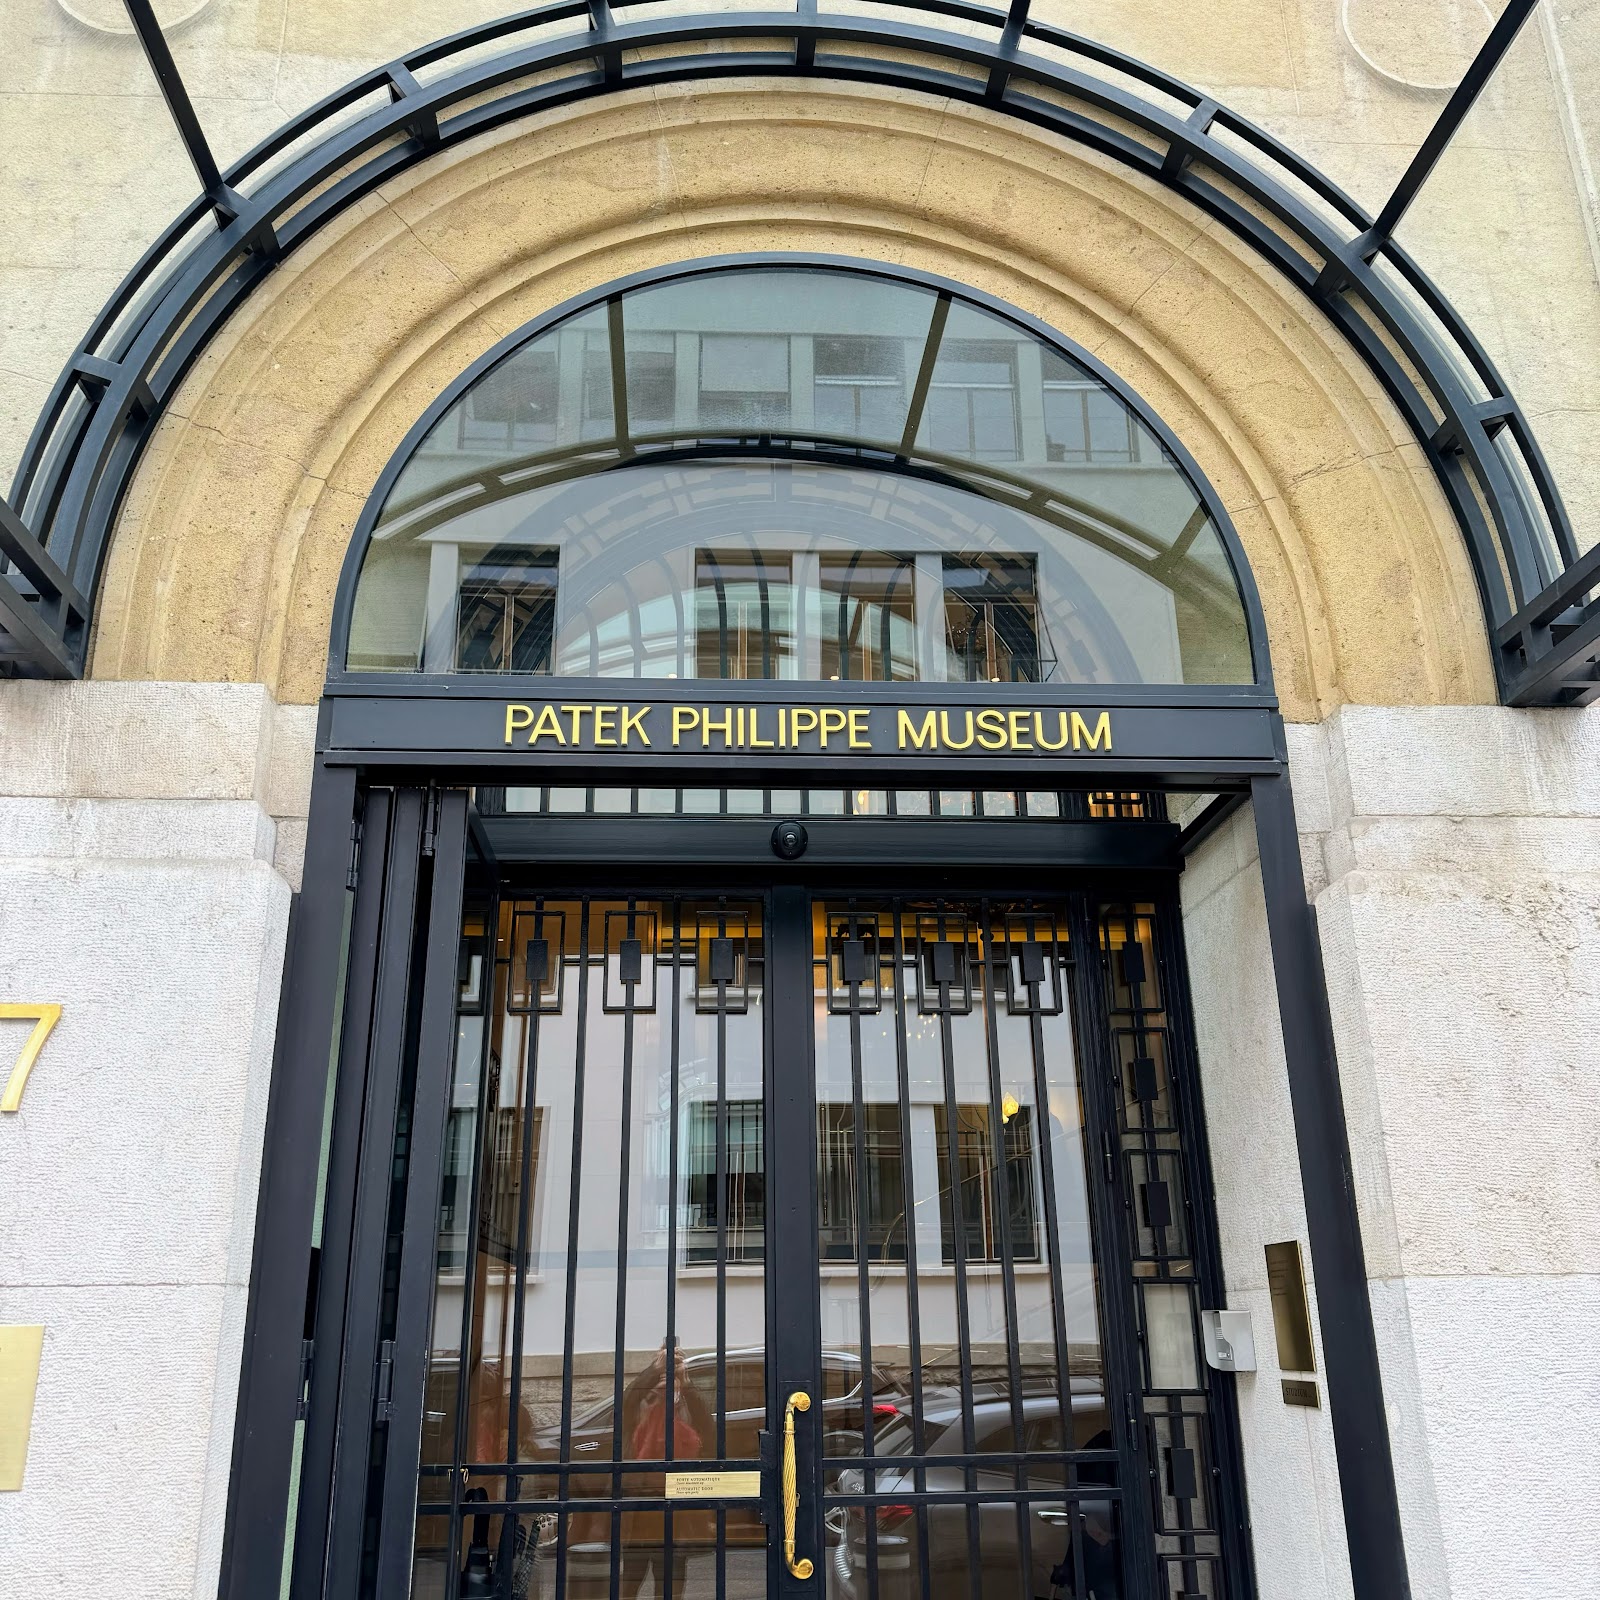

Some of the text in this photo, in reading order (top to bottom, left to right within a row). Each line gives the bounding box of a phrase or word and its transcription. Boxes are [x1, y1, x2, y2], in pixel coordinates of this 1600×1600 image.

[505, 704, 1112, 751] PATEK PHILIPPE MUSEUM
[0, 1002, 62, 1112] 7
